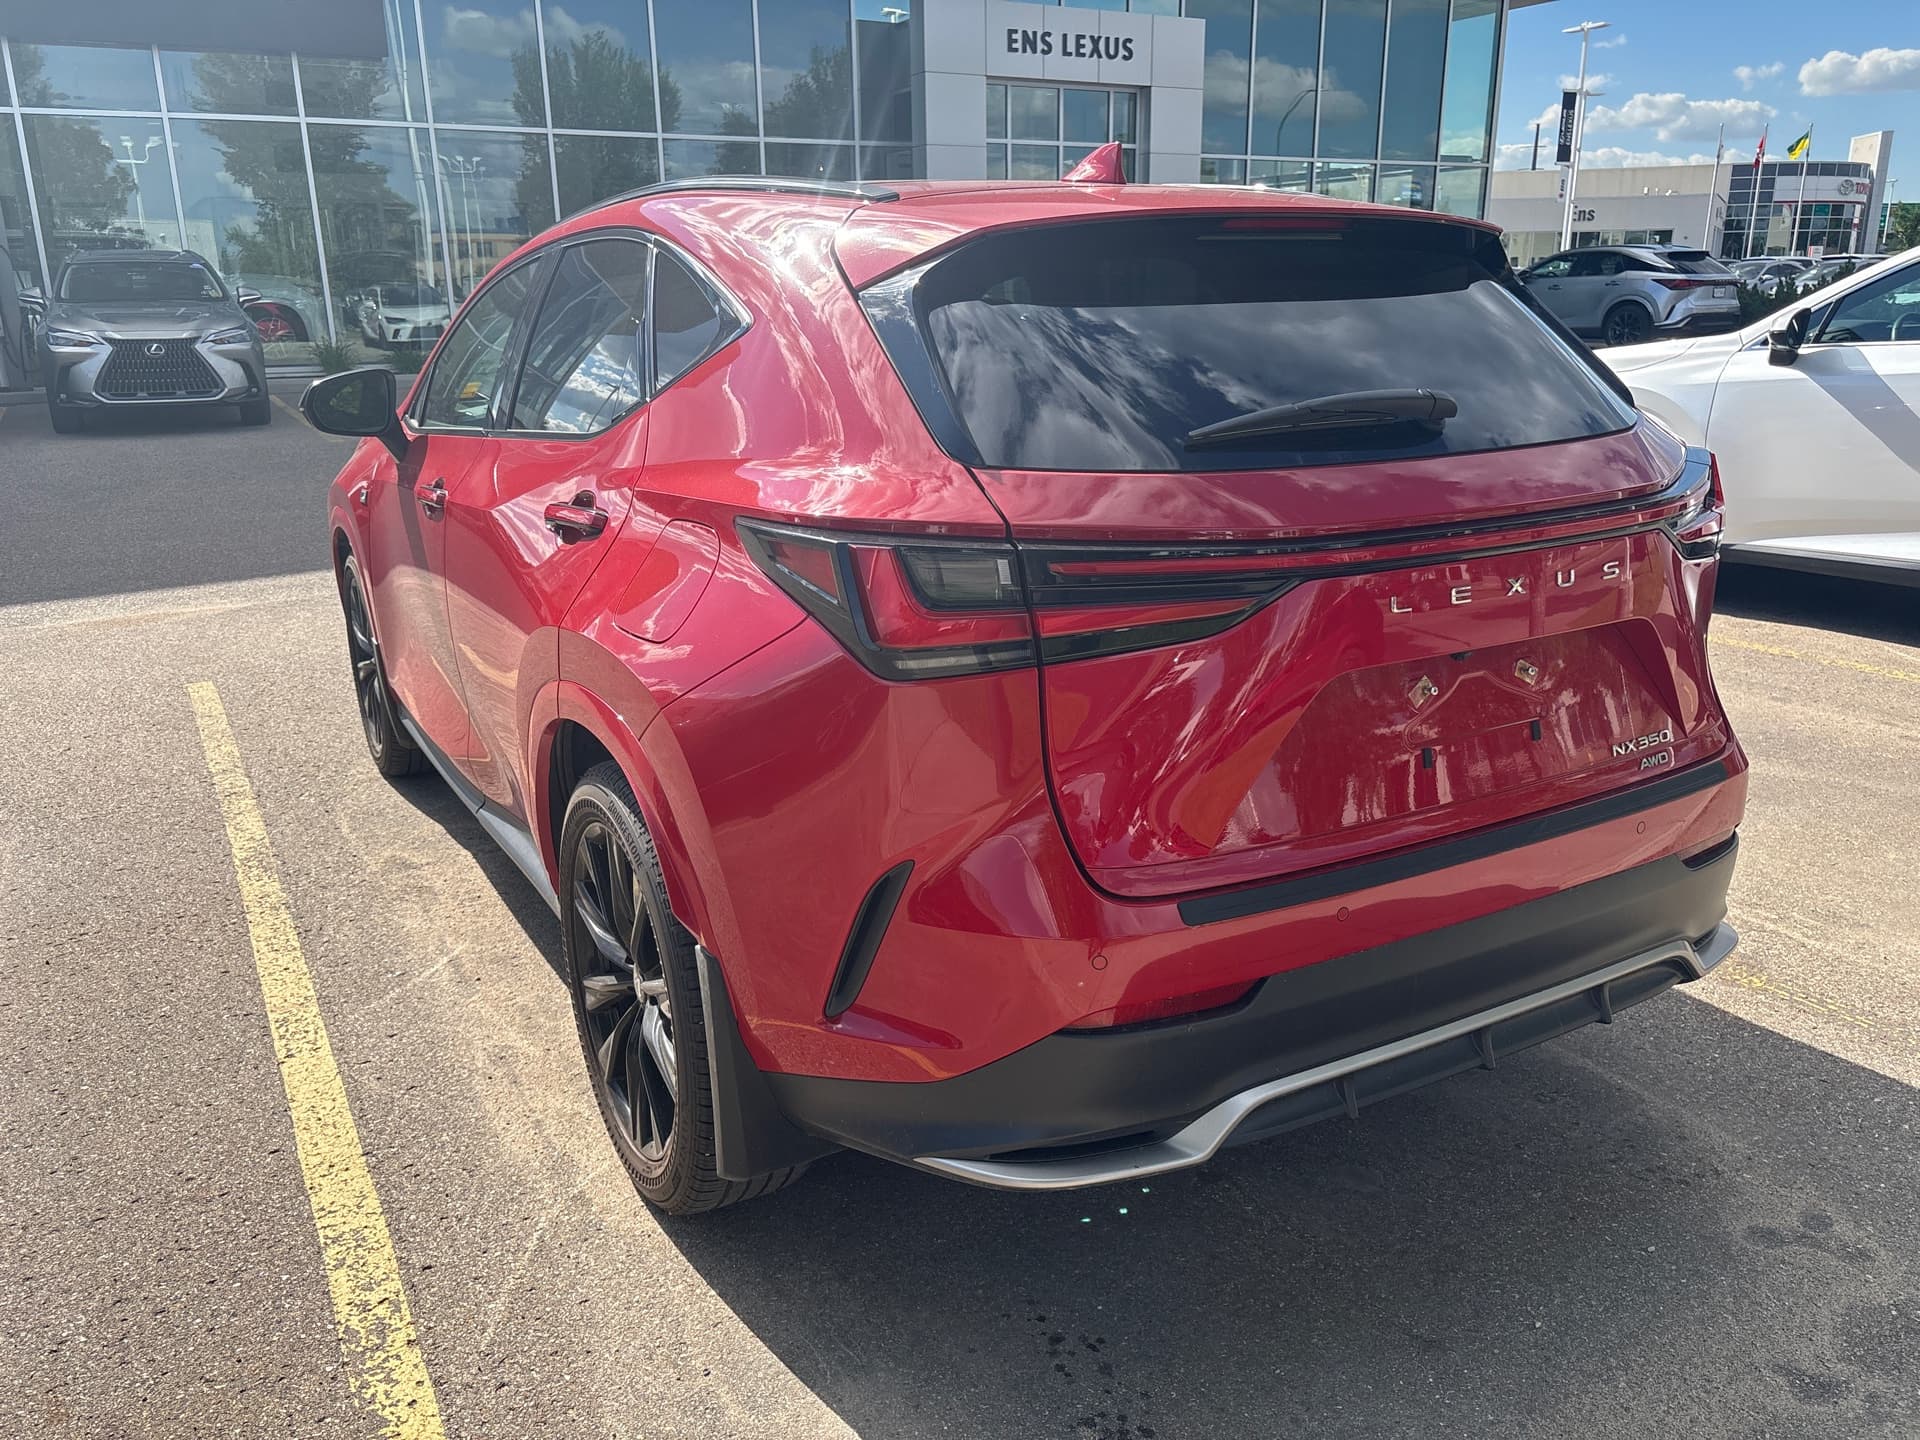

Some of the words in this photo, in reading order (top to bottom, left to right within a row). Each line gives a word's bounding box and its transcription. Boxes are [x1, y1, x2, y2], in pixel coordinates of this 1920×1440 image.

[1007, 28, 1053, 55] ENS
[1061, 33, 1134, 61] LEXUS
[1391, 561, 1620, 614] LEXUS
[1612, 729, 1670, 757] NX350
[1641, 752, 1668, 770] AWD
[608, 800, 643, 870] BRIDGESTONE
